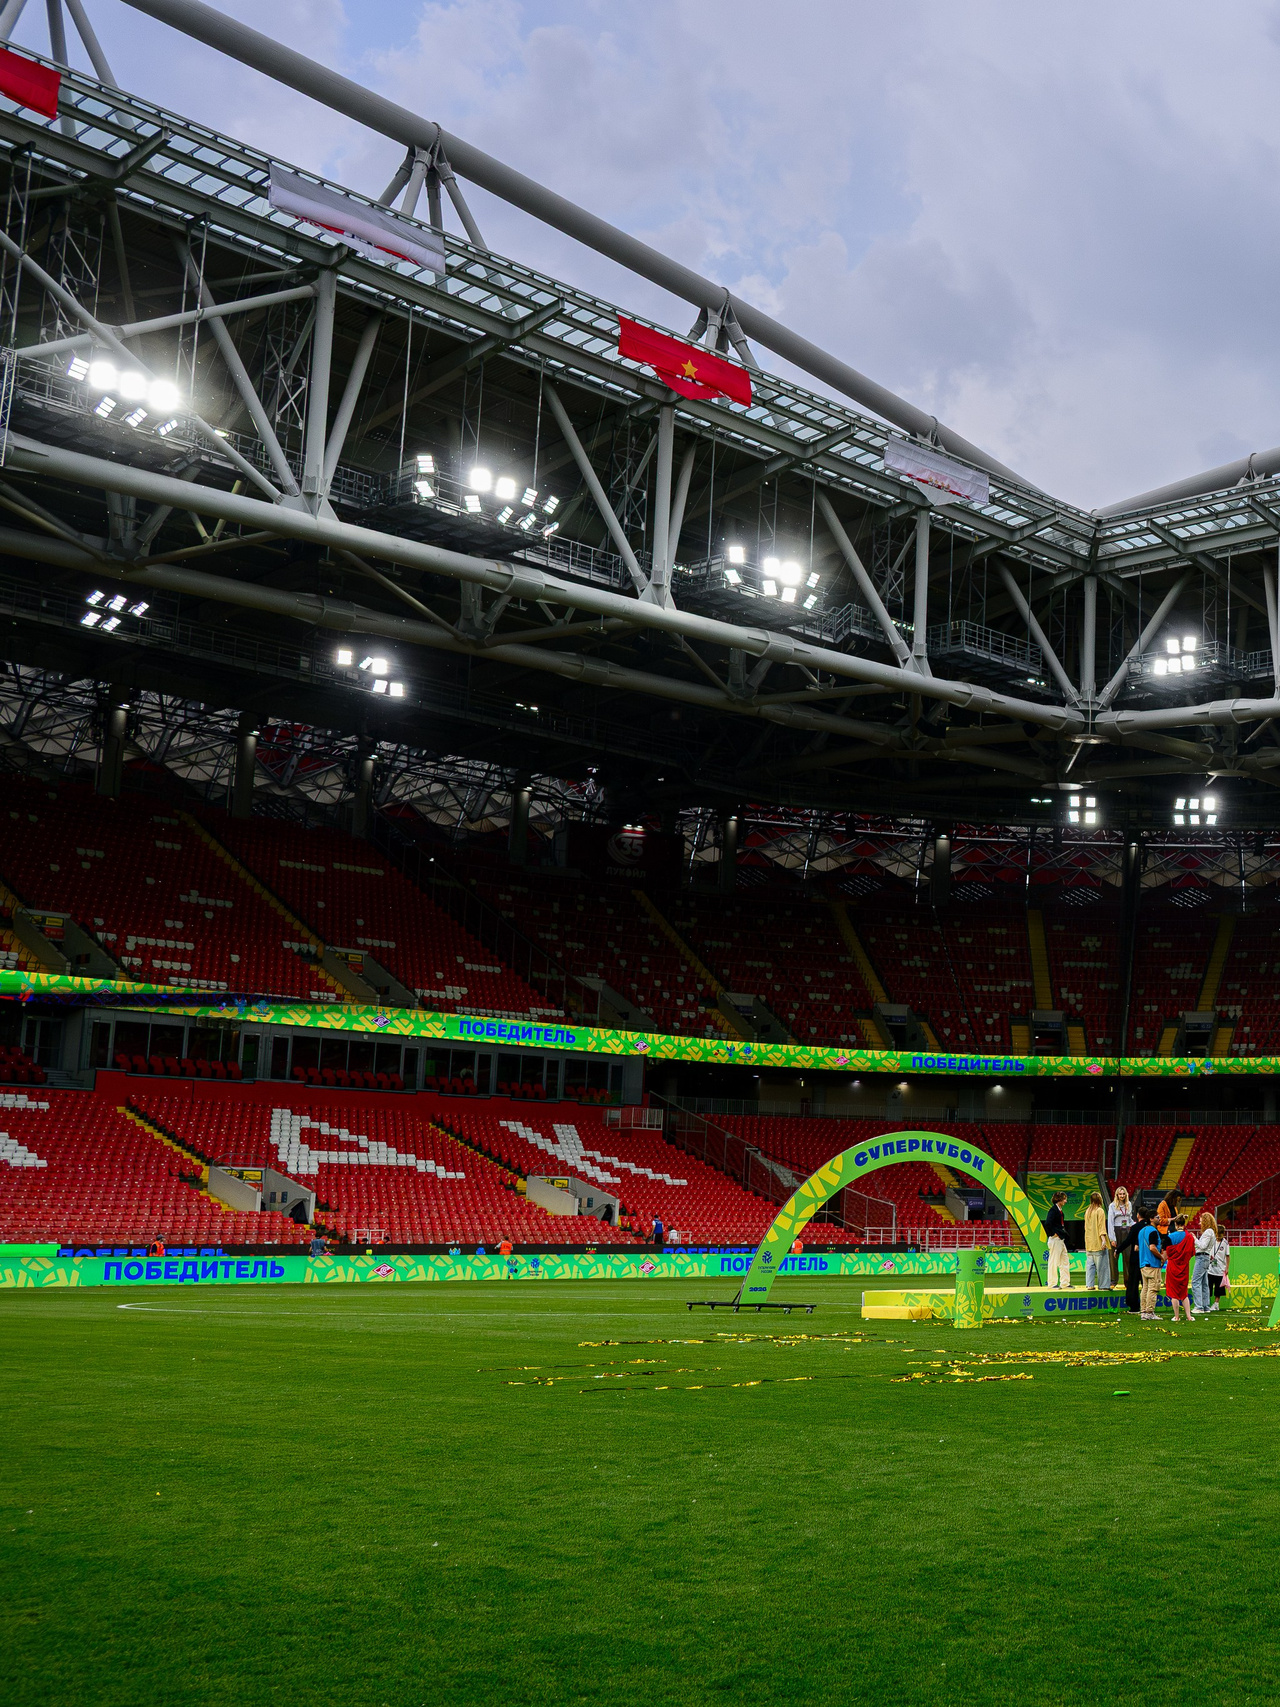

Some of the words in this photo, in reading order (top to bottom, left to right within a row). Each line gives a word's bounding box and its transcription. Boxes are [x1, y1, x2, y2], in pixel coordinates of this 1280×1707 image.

[620, 839, 643, 856] 35
[459, 1020, 576, 1044] ПОБЕДИТЕЛЬ
[912, 1056, 1025, 1072] ПОБЕДИТЕЛЬ
[854, 1138, 986, 1172] СУПЕРКУБОК
[103, 1261, 285, 1283] ПОБЕДИТЕЛЬ
[720, 1256, 829, 1272] ПОИТЕЛЬ
[1044, 1296, 1128, 1312] СУПЕРКУБ
